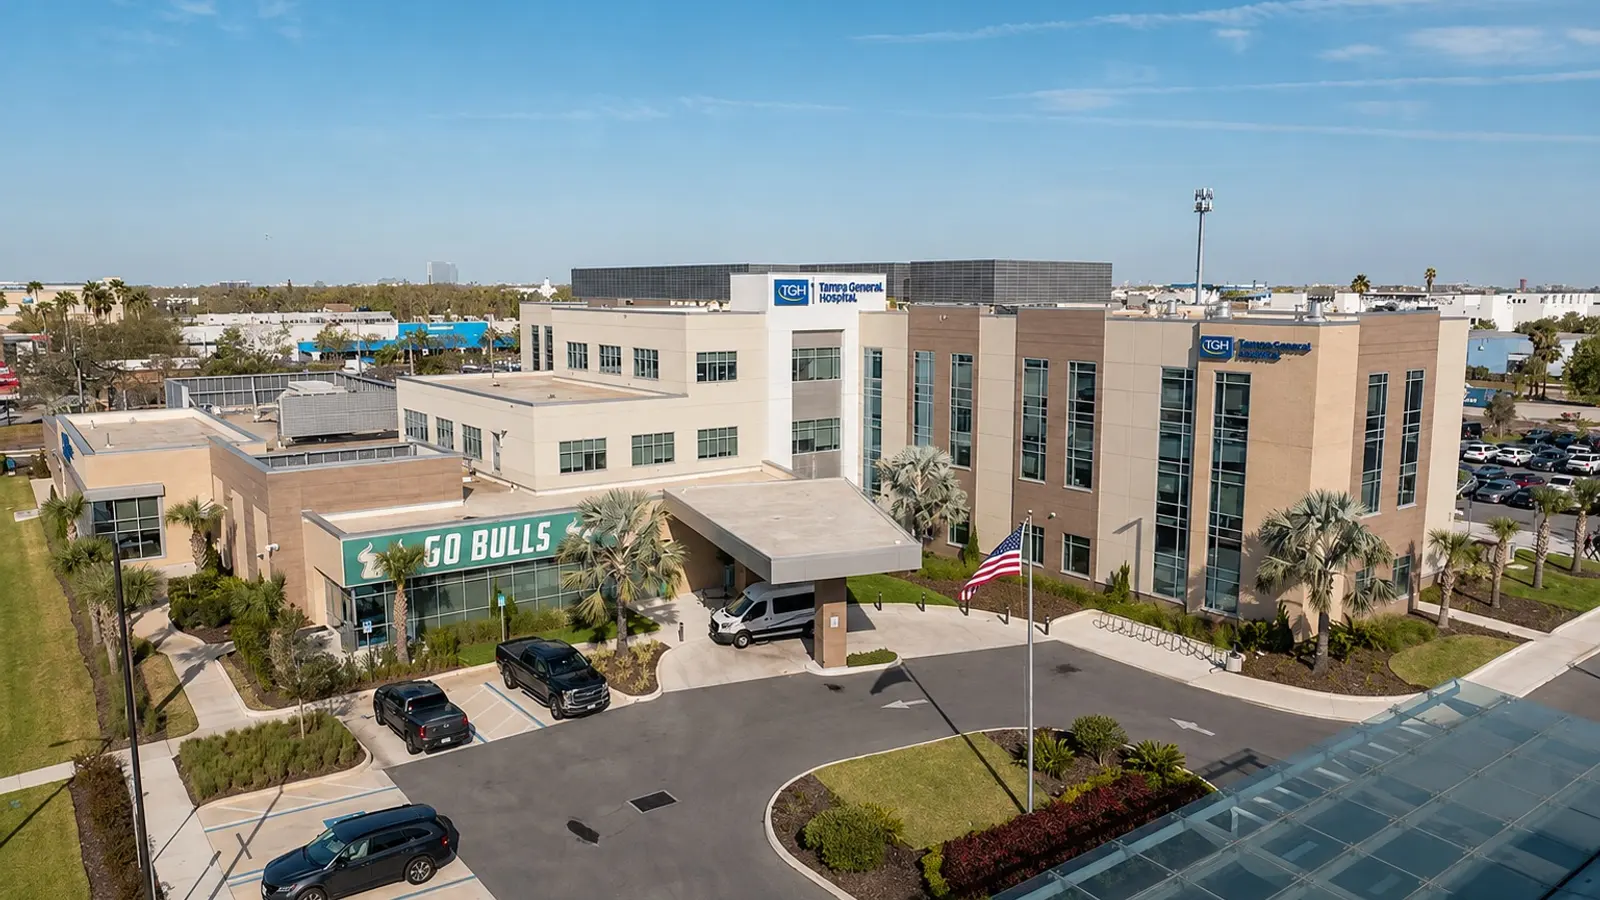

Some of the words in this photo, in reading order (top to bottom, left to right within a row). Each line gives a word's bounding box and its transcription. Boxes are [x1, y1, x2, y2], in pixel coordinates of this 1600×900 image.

[782, 285, 806, 296] TGH
[819, 283, 847, 293] Tampa
[849, 282, 884, 292] General
[819, 294, 857, 304] Hospital
[1206, 340, 1229, 350] TGH
[423, 533, 461, 568] GO
[470, 521, 551, 561] BULLS
